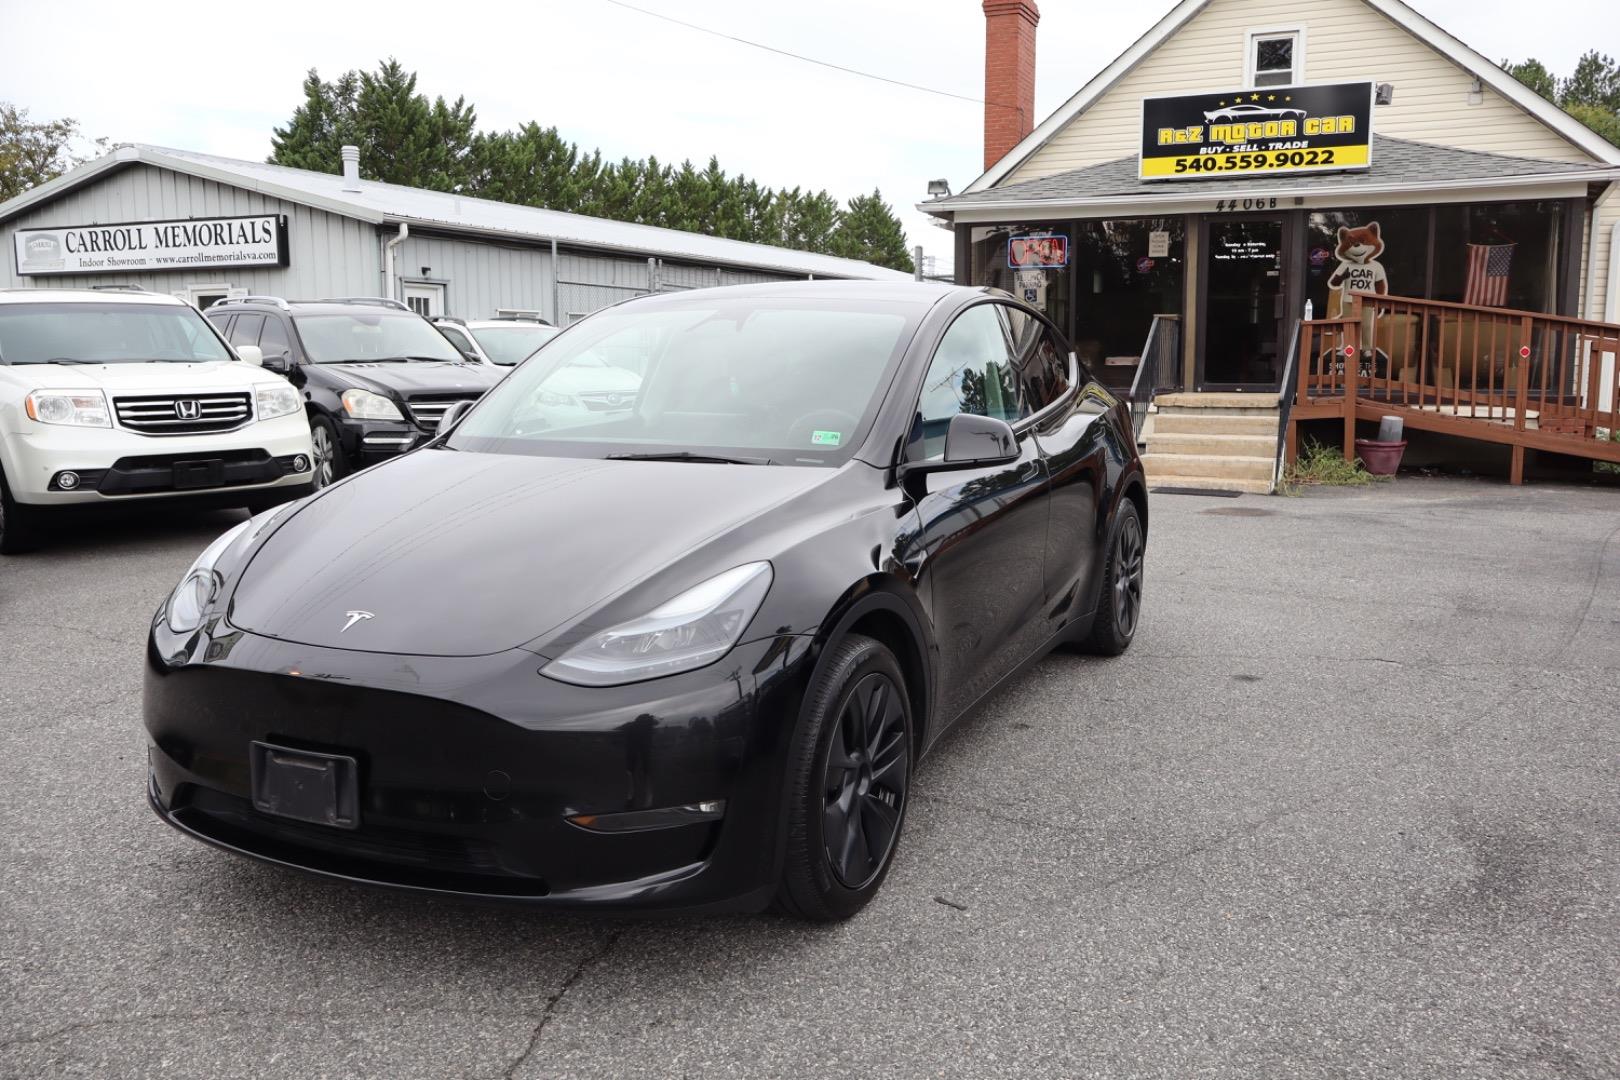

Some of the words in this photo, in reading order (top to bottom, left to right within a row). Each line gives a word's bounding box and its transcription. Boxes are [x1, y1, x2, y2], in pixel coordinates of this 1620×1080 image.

[1158, 126, 1204, 145] R&Z
[1199, 145, 1224, 155] BUY
[1232, 143, 1259, 153] SELL
[1268, 140, 1309, 150] TRADE
[1174, 149, 1335, 174] 540.559.9022
[1216, 197, 1278, 211] 4406B
[65, 228, 148, 254] CARROLL
[153, 219, 273, 249] MEMORIALS
[79, 257, 105, 268] Indoor
[106, 255, 147, 267] Showroom
[155, 250, 277, 265] www.carrollmemorialsva.com
[1351, 269, 1374, 280] CAR
[1350, 279, 1372, 290] FOX
